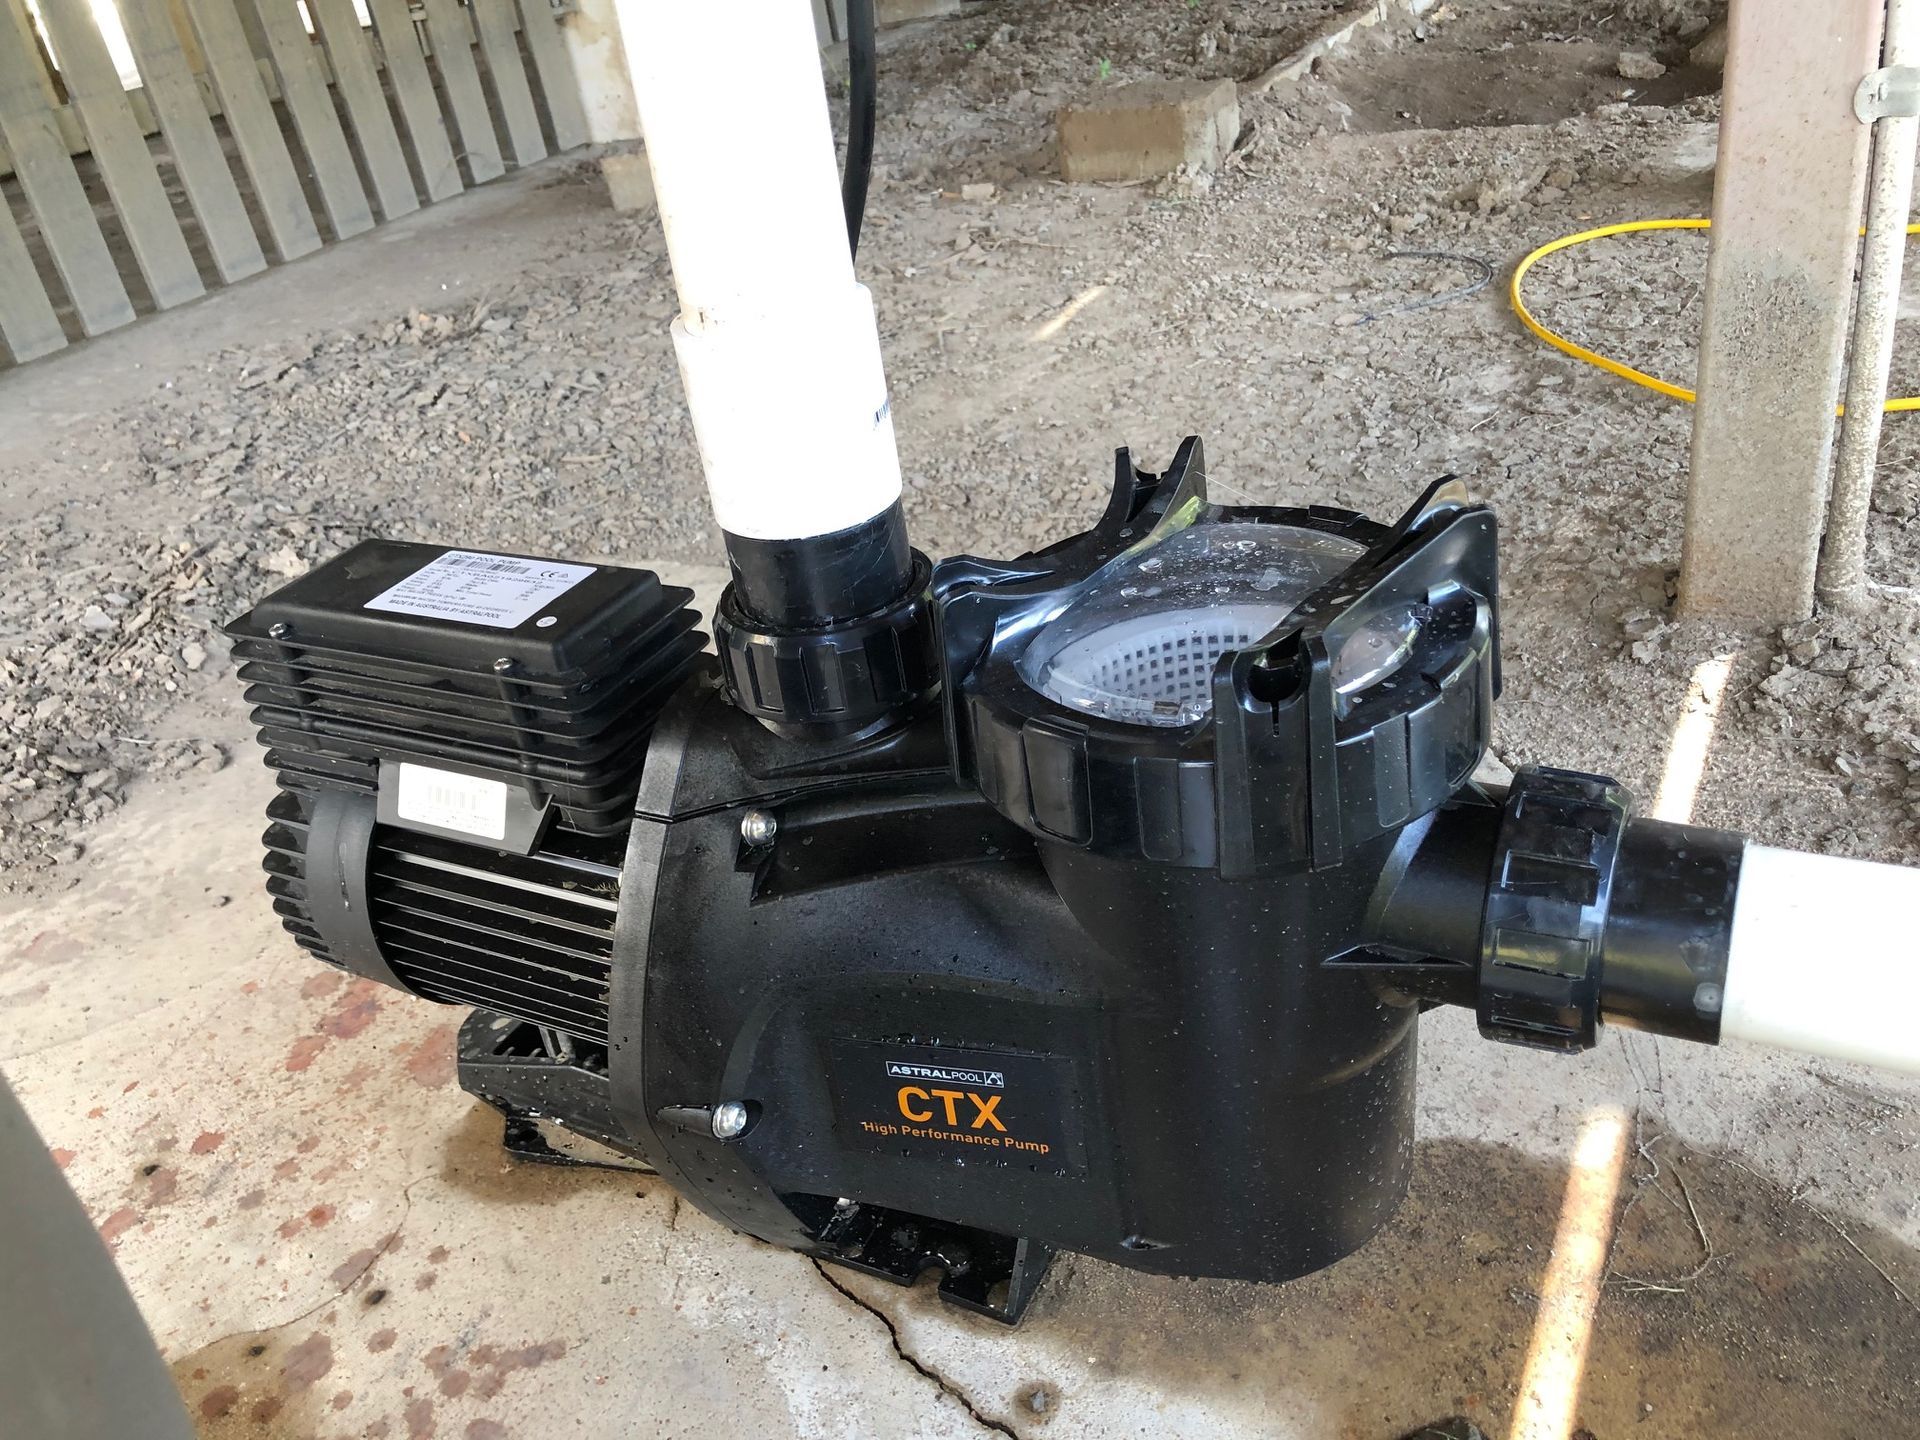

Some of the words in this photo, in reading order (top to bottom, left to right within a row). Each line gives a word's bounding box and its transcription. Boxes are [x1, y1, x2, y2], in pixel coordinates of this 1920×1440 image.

[416, 602, 450, 612] AUSTRALIA
[890, 1064, 983, 1083] ASTRALPOOL
[897, 1086, 1008, 1132] CTX
[863, 1121, 898, 1136] High
[902, 1124, 1000, 1147] Performance
[1004, 1137, 1050, 1155] Pump
